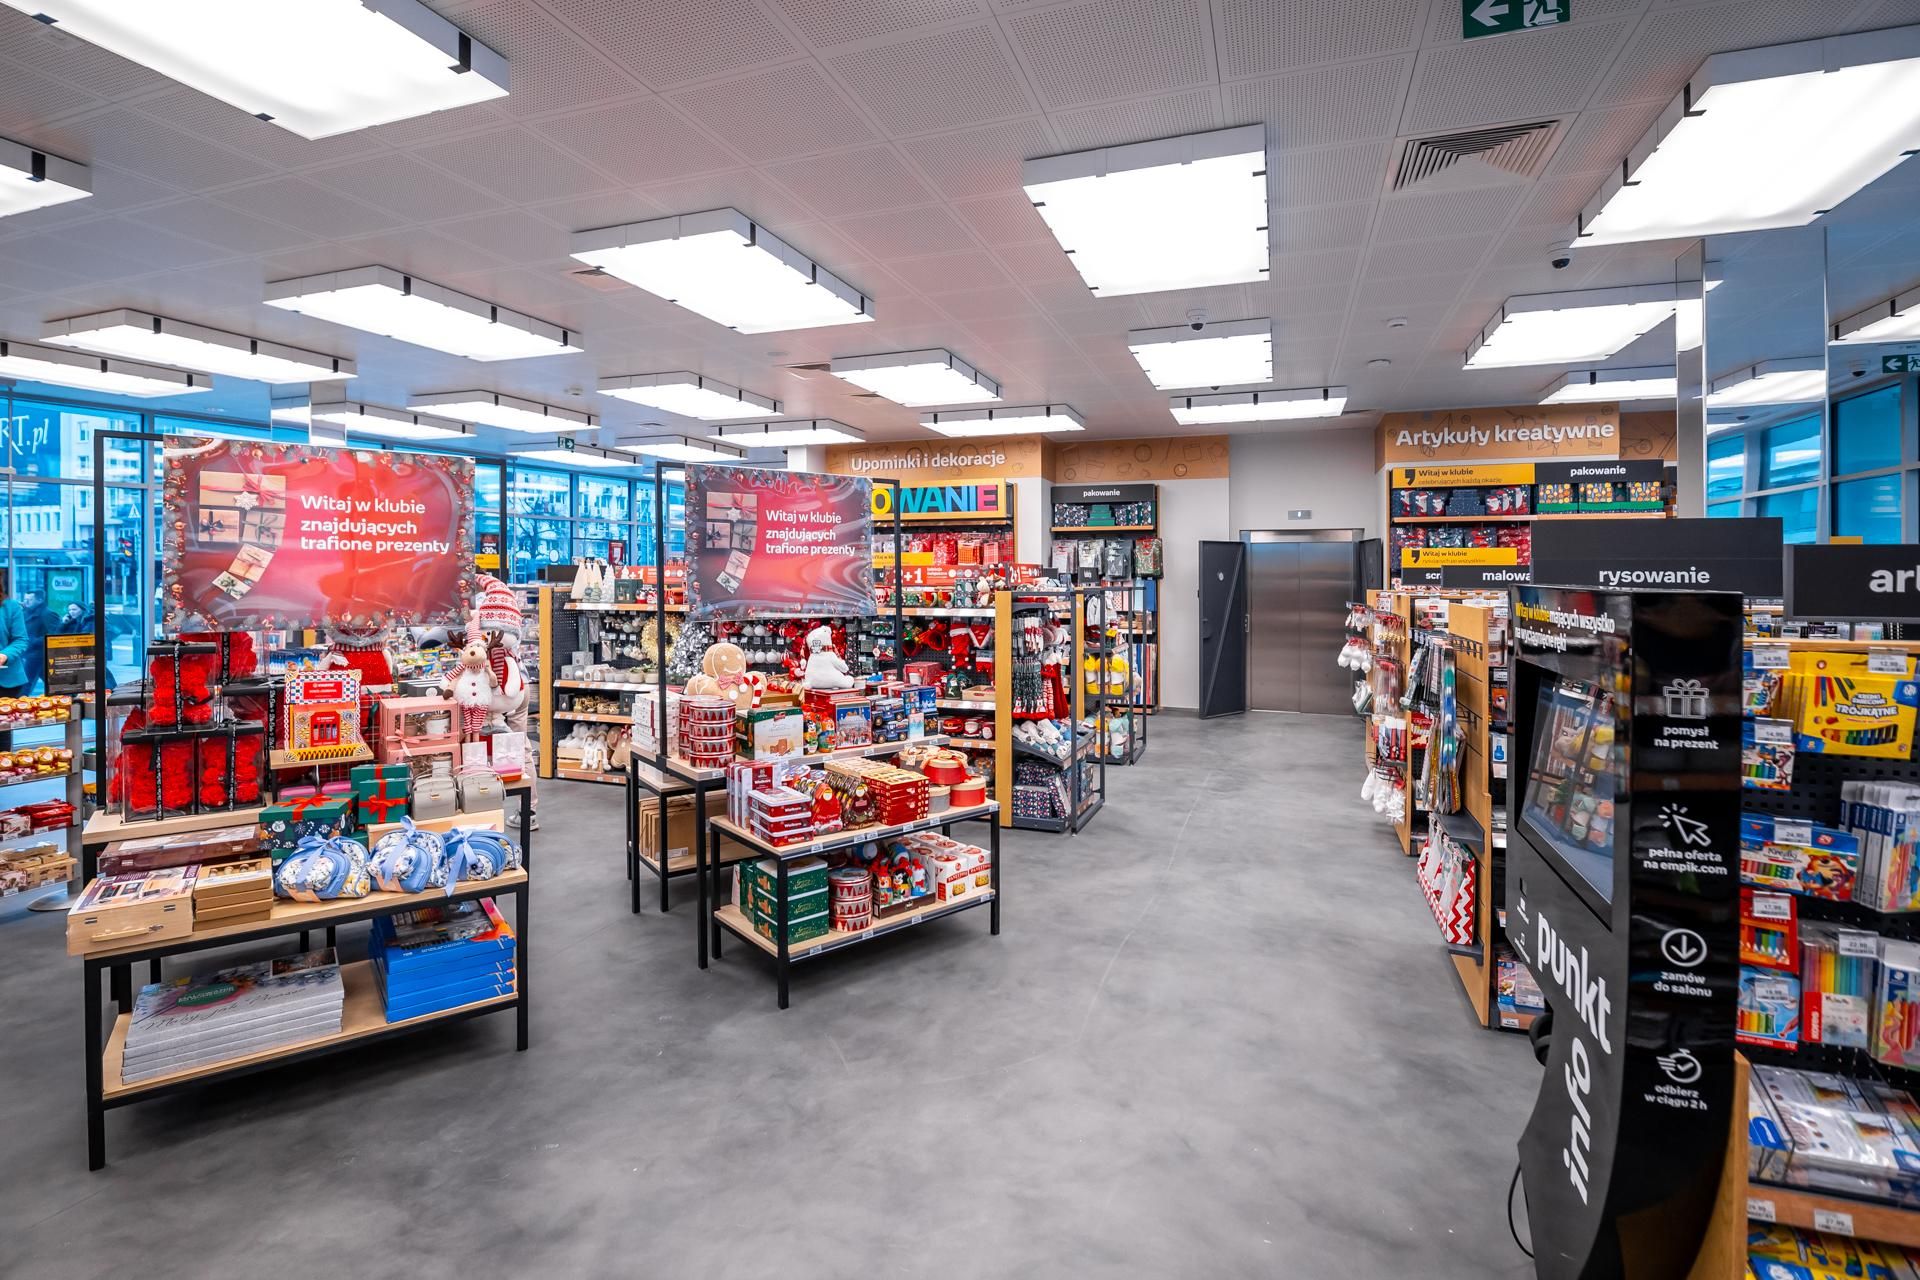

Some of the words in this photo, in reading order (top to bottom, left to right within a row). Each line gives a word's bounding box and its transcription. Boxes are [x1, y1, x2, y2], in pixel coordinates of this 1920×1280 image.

[1396, 422, 1490, 449] Artykuły
[1495, 421, 1615, 443] kreatywne
[851, 455, 919, 473] Upominki
[923, 453, 929, 466] i
[932, 451, 1005, 469] dekoracje
[1419, 469, 1440, 478] Witaj
[1449, 468, 1473, 476] klubie
[1570, 465, 1627, 478] pakowanie
[1083, 489, 1120, 498] pakowanie
[301, 494, 352, 515] Witaj
[354, 499, 371, 512] w
[373, 496, 425, 514] klubie
[766, 508, 796, 526] Witaj
[798, 513, 809, 524] w
[811, 511, 841, 525] klubie
[301, 517, 417, 537] znajdujących
[766, 528, 836, 543] znajdujących
[301, 536, 372, 552] trafione
[376, 539, 450, 556] prezenty
[766, 541, 808, 555] trafione
[810, 543, 855, 559] prezenty
[1422, 550, 1440, 559] Witaj
[1599, 566, 1710, 585] rysowanie
[1515, 602, 1529, 621] Witaj
[1550, 606, 1579, 629] mających
[1579, 611, 1616, 634] wszystko
[1836, 703, 1898, 719] TRÓJKĄTNE
[1663, 726, 1709, 738] pomysł
[1654, 738, 1669, 747] na
[1671, 738, 1719, 750] prezent
[1648, 848, 1683, 860] pełna
[1685, 850, 1722, 862] oferta
[1643, 860, 1658, 869] na
[1660, 861, 1728, 876] empik.com
[1537, 911, 1612, 1055] punkt
[1661, 971, 1706, 984] zamów
[1653, 981, 1670, 992] do
[1671, 984, 1712, 997] salonu
[1654, 1085, 1699, 1098] odbierz
[1644, 1094, 1656, 1103] w
[1656, 1095, 1689, 1108] ciągu
[1690, 1099, 1698, 1109] 2
[1699, 1099, 1708, 1110] h
[1563, 1036, 1591, 1206] info
